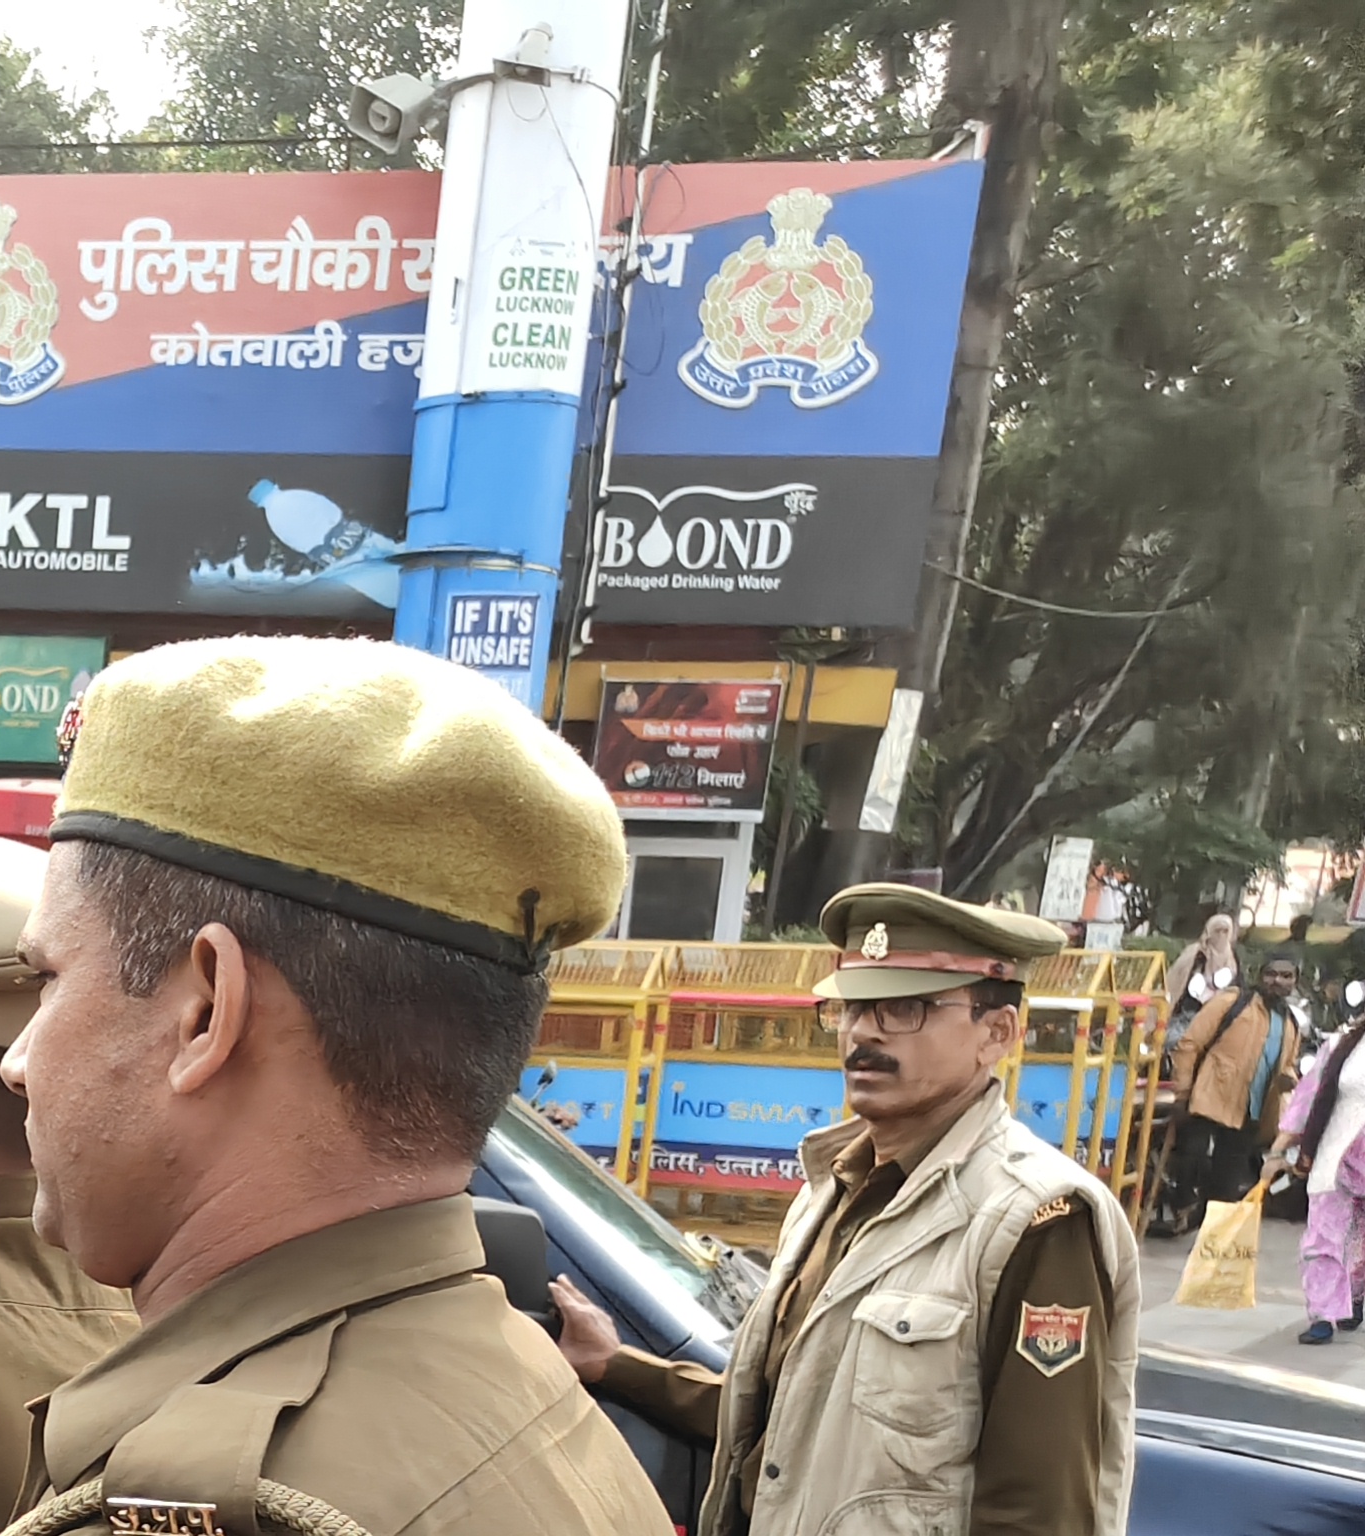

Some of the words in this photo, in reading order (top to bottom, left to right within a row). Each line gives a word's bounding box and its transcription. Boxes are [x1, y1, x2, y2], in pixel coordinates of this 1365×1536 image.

[78, 217, 245, 321] पुलिस
[248, 215, 397, 292] चौकी
[499, 267, 580, 295] GREEN
[495, 296, 575, 316] LUCKNOW
[150, 320, 348, 370] कोतवाली
[491, 322, 572, 350] CLEAN
[488, 353, 568, 371] LUCKNOW
[597, 572, 669, 591] Packaged
[671, 573, 734, 592] Drinking
[738, 574, 782, 592] Water
[454, 600, 482, 634] IF
[487, 600, 534, 634] IT'S
[450, 636, 532, 666] UNSAFE
